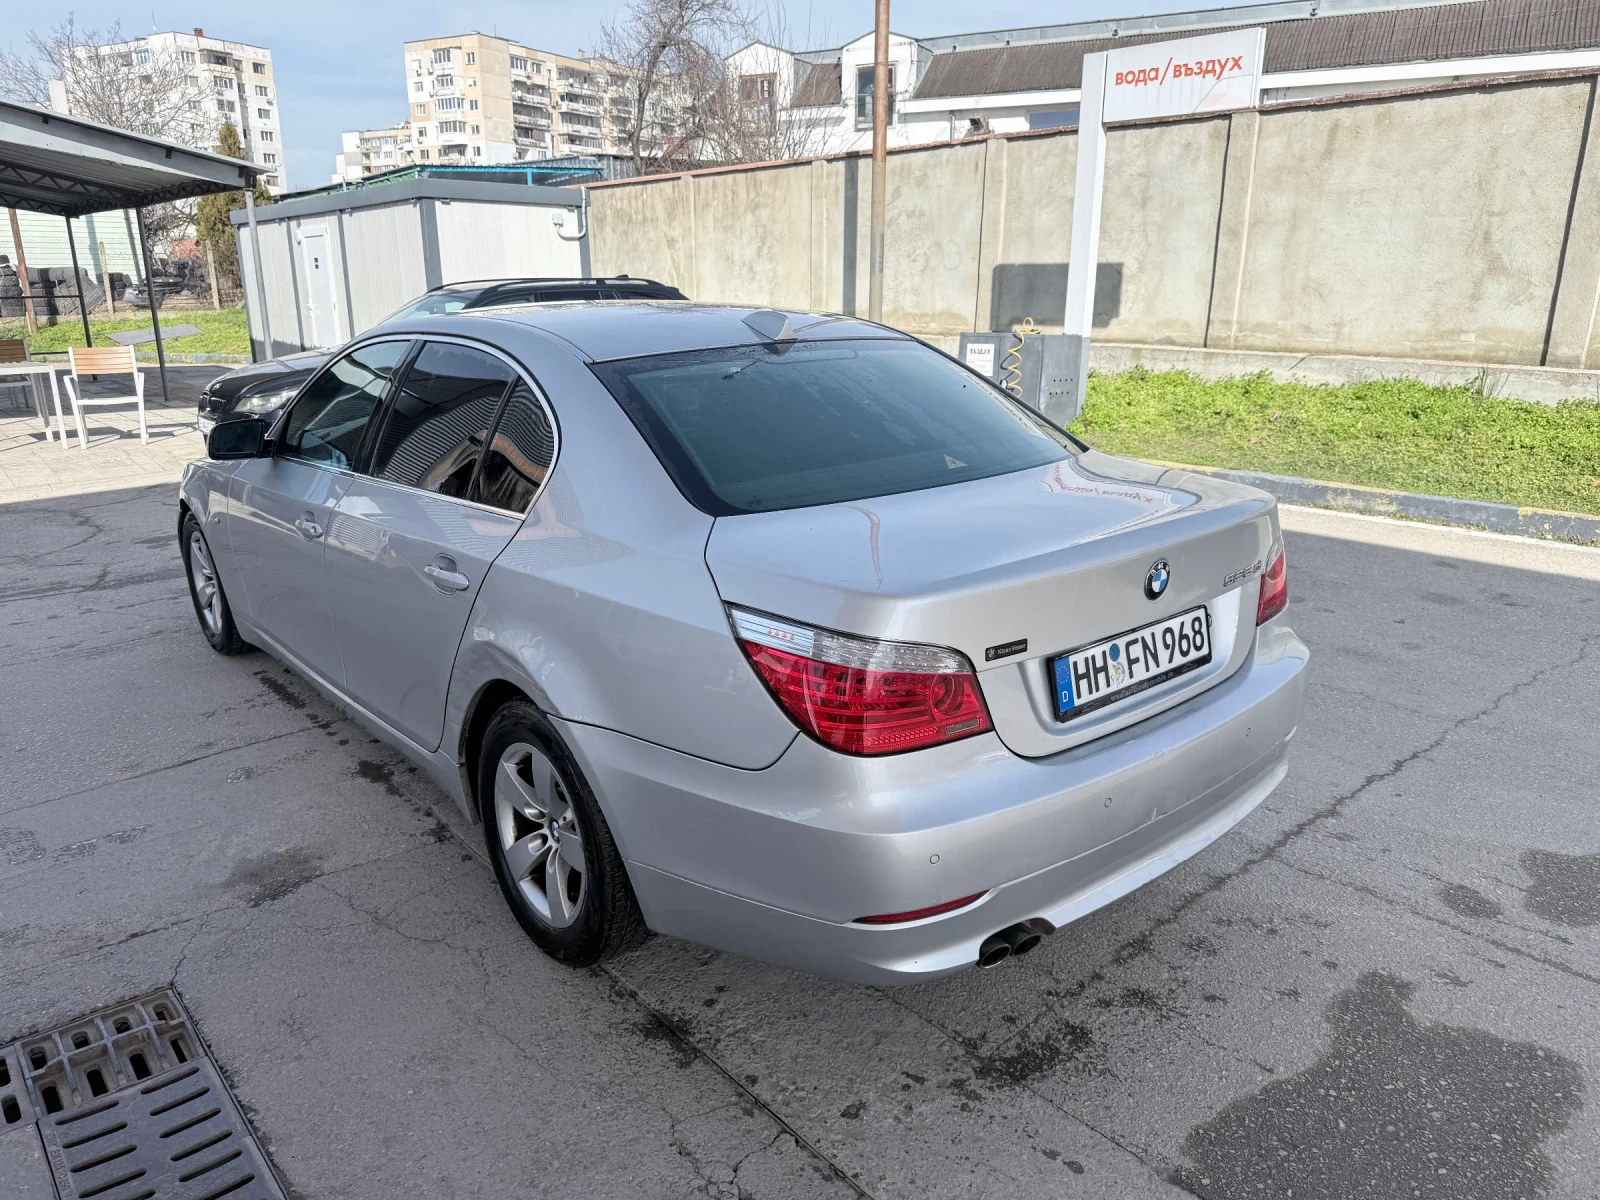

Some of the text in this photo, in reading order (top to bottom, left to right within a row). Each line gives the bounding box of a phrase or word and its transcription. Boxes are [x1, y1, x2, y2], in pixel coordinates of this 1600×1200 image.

[1115, 56, 1243, 87] вода/въздух
[1072, 616, 1205, 700] HH FN 968
[1062, 690, 1069, 703] D
